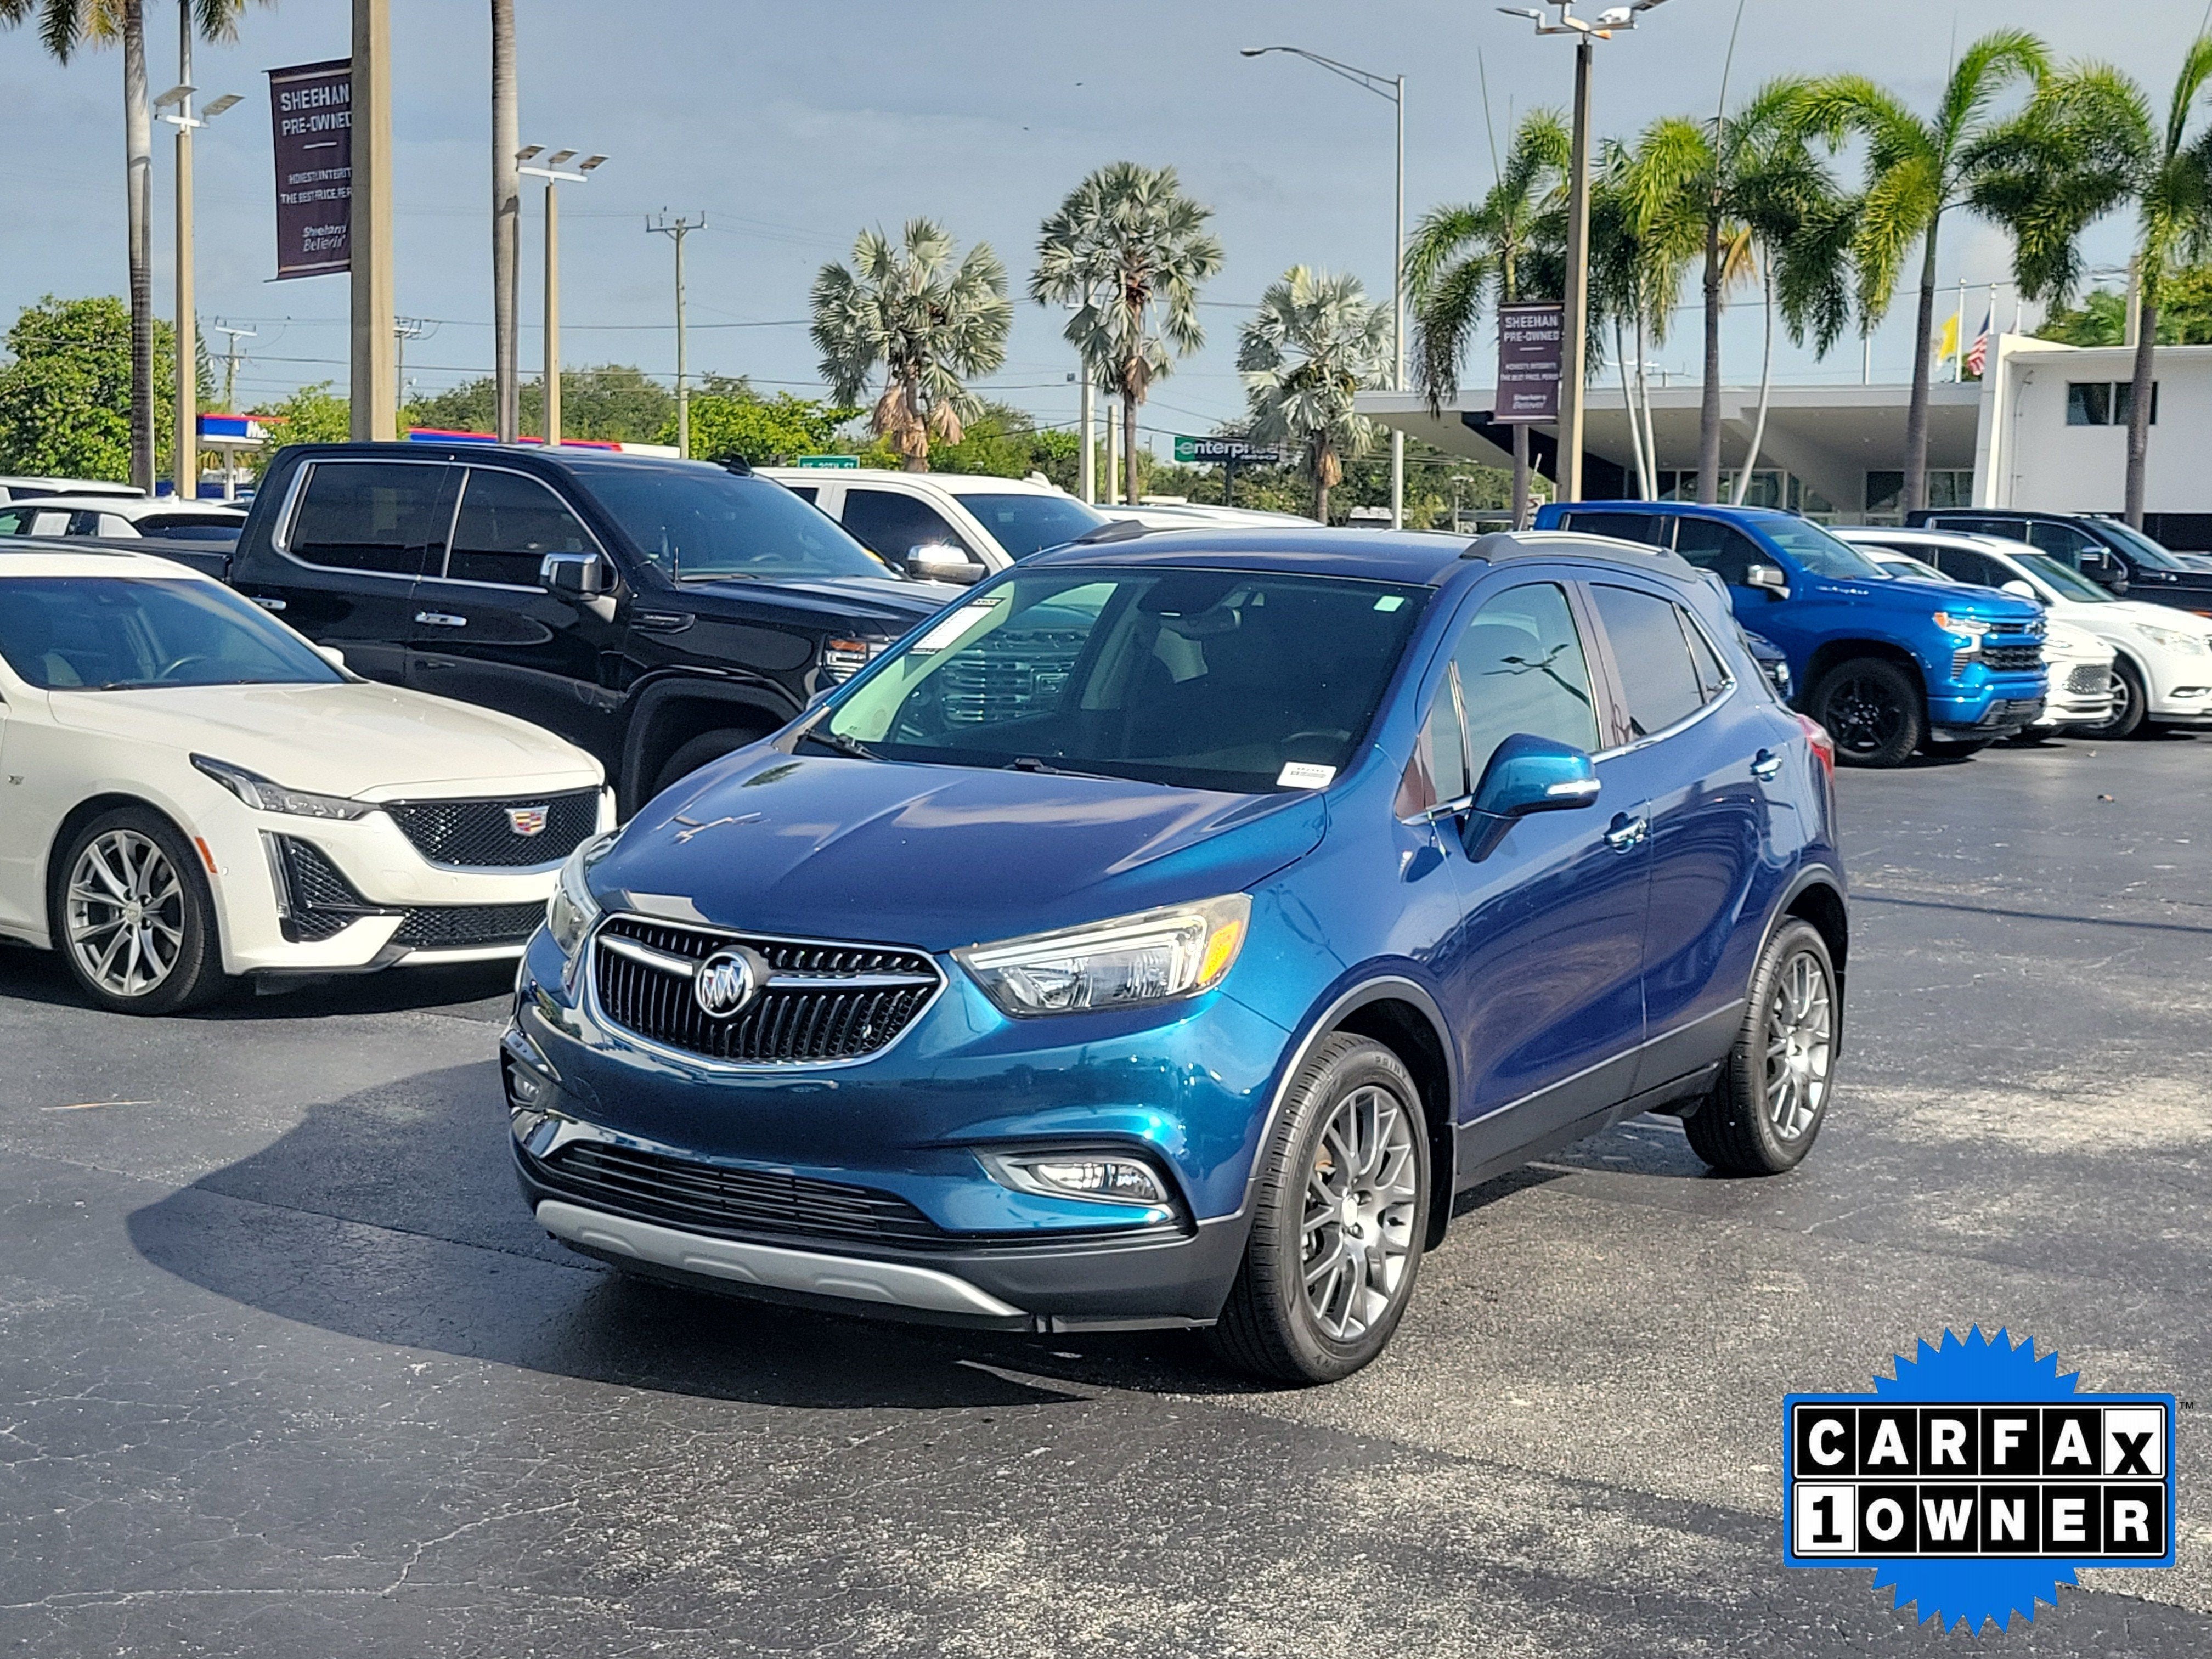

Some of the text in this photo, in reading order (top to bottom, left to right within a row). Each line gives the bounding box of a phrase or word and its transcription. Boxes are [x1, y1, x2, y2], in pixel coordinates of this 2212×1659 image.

[280, 83, 350, 112] SHEEHAN
[281, 111, 352, 136] PRE-OWNED
[1505, 315, 1558, 329] SHEEHAN
[1503, 330, 1560, 342] PRE-OWNED
